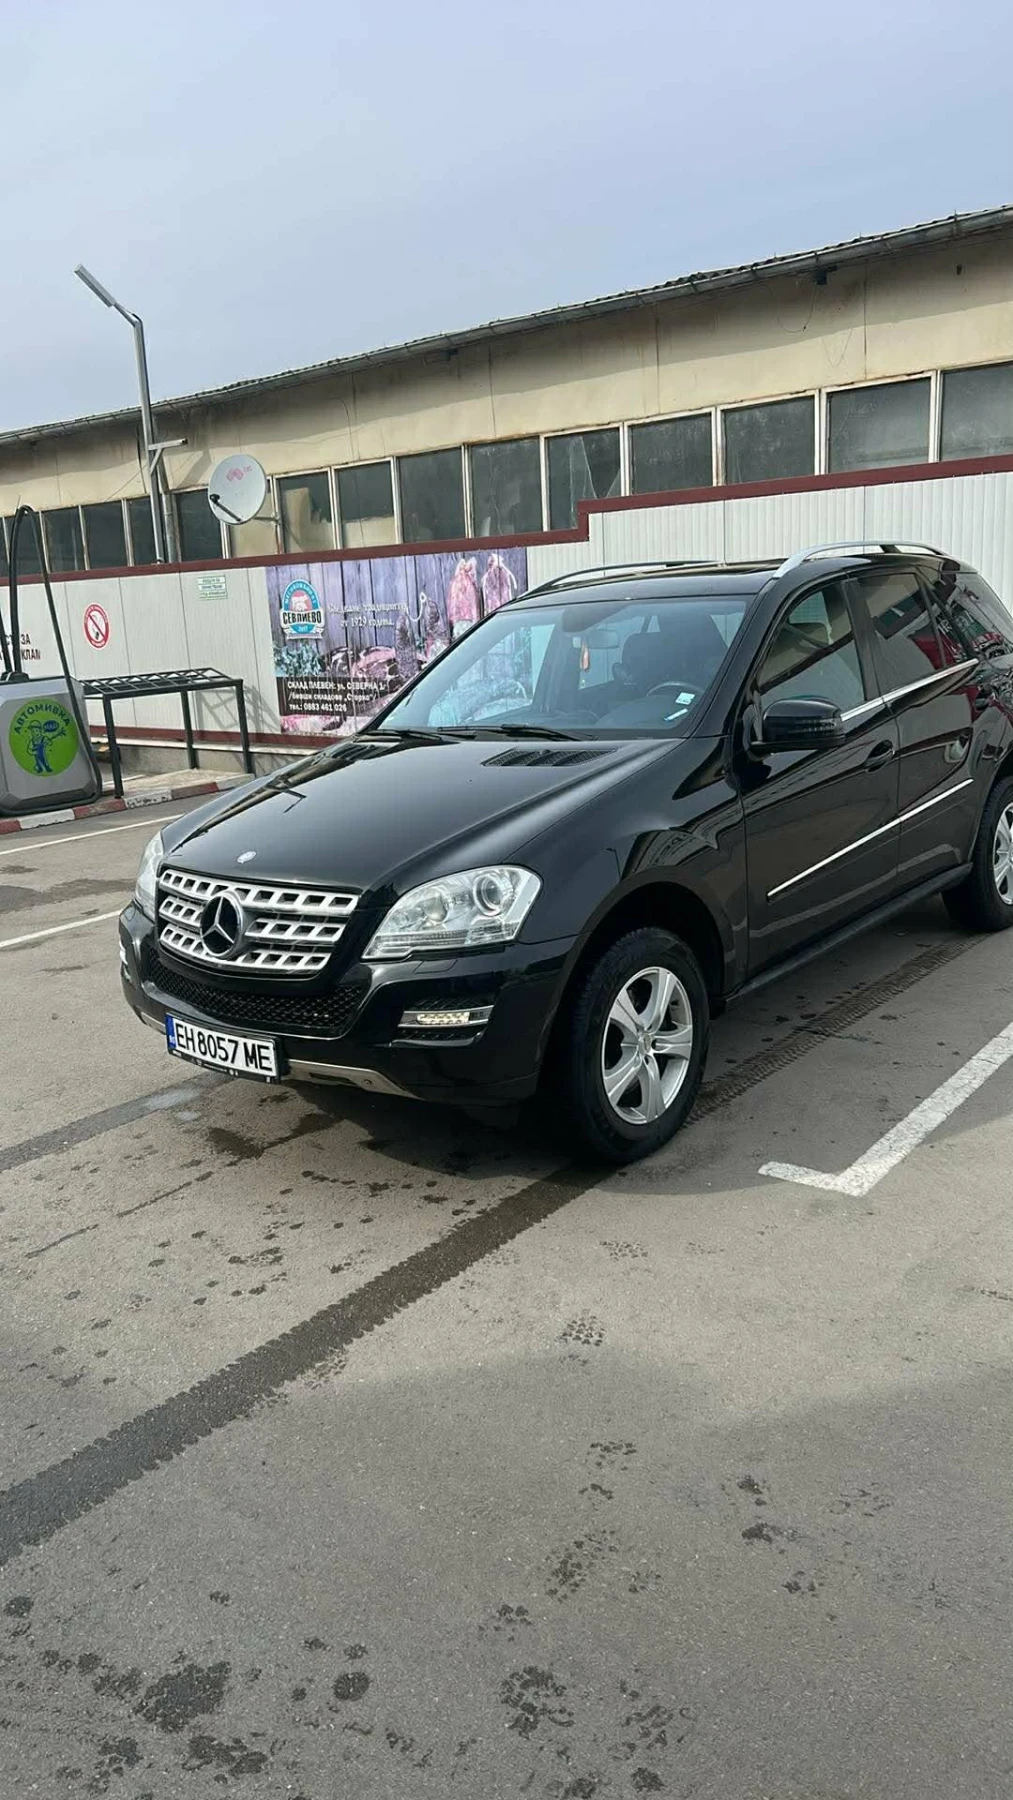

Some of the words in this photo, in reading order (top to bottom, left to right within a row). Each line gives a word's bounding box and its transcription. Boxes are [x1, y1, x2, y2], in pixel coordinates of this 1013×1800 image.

[282, 610, 322, 625] СЕВЛИЕВО
[350, 615, 367, 628] 1929
[20, 633, 31, 645] ЗА
[287, 681, 309, 690] СКЛАД
[309, 681, 336, 690] ПЛЕВЕН:
[346, 681, 380, 690] СЕВЕРНА
[320, 703, 333, 712] 461
[334, 703, 347, 712] 026
[14, 704, 70, 735] АВТОМИВКА
